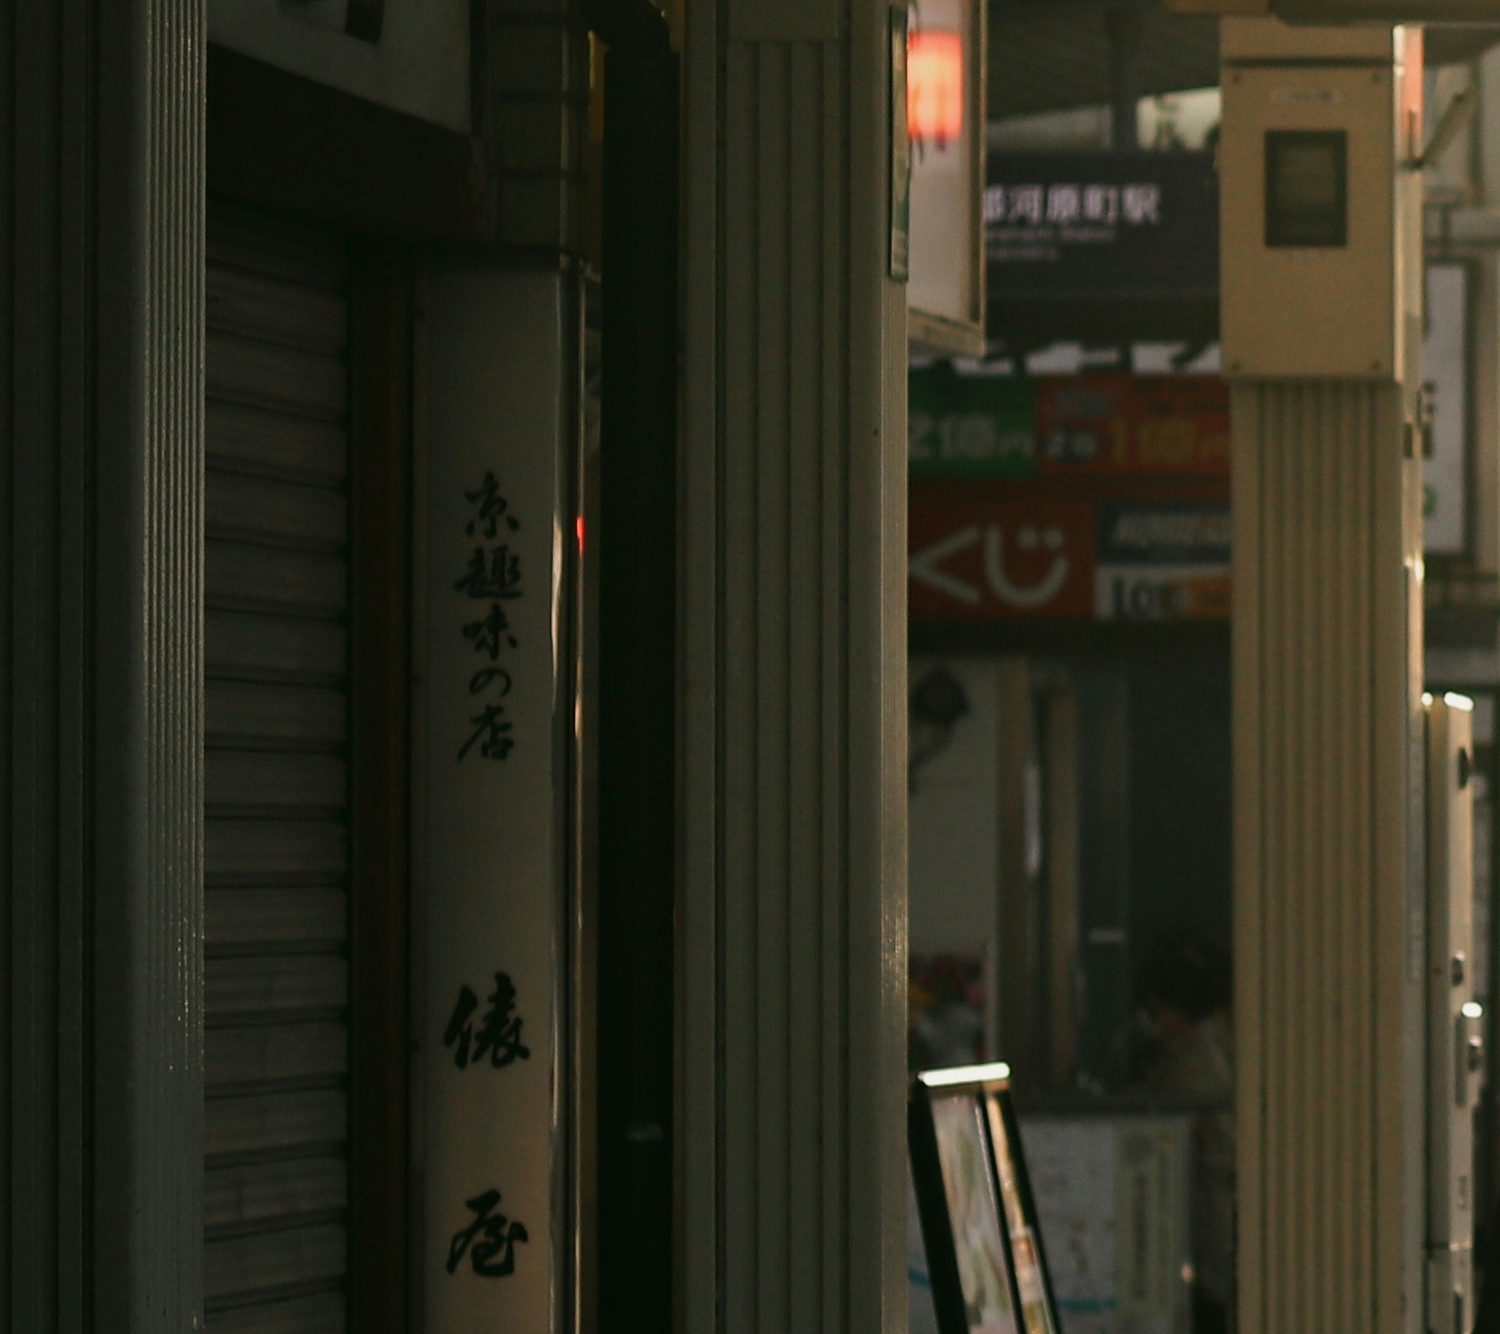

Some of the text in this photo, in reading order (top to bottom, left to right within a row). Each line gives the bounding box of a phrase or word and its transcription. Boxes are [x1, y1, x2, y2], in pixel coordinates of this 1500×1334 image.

[453, 470, 523, 765] 京趣味の店
[443, 970, 531, 1280] 俵屋
